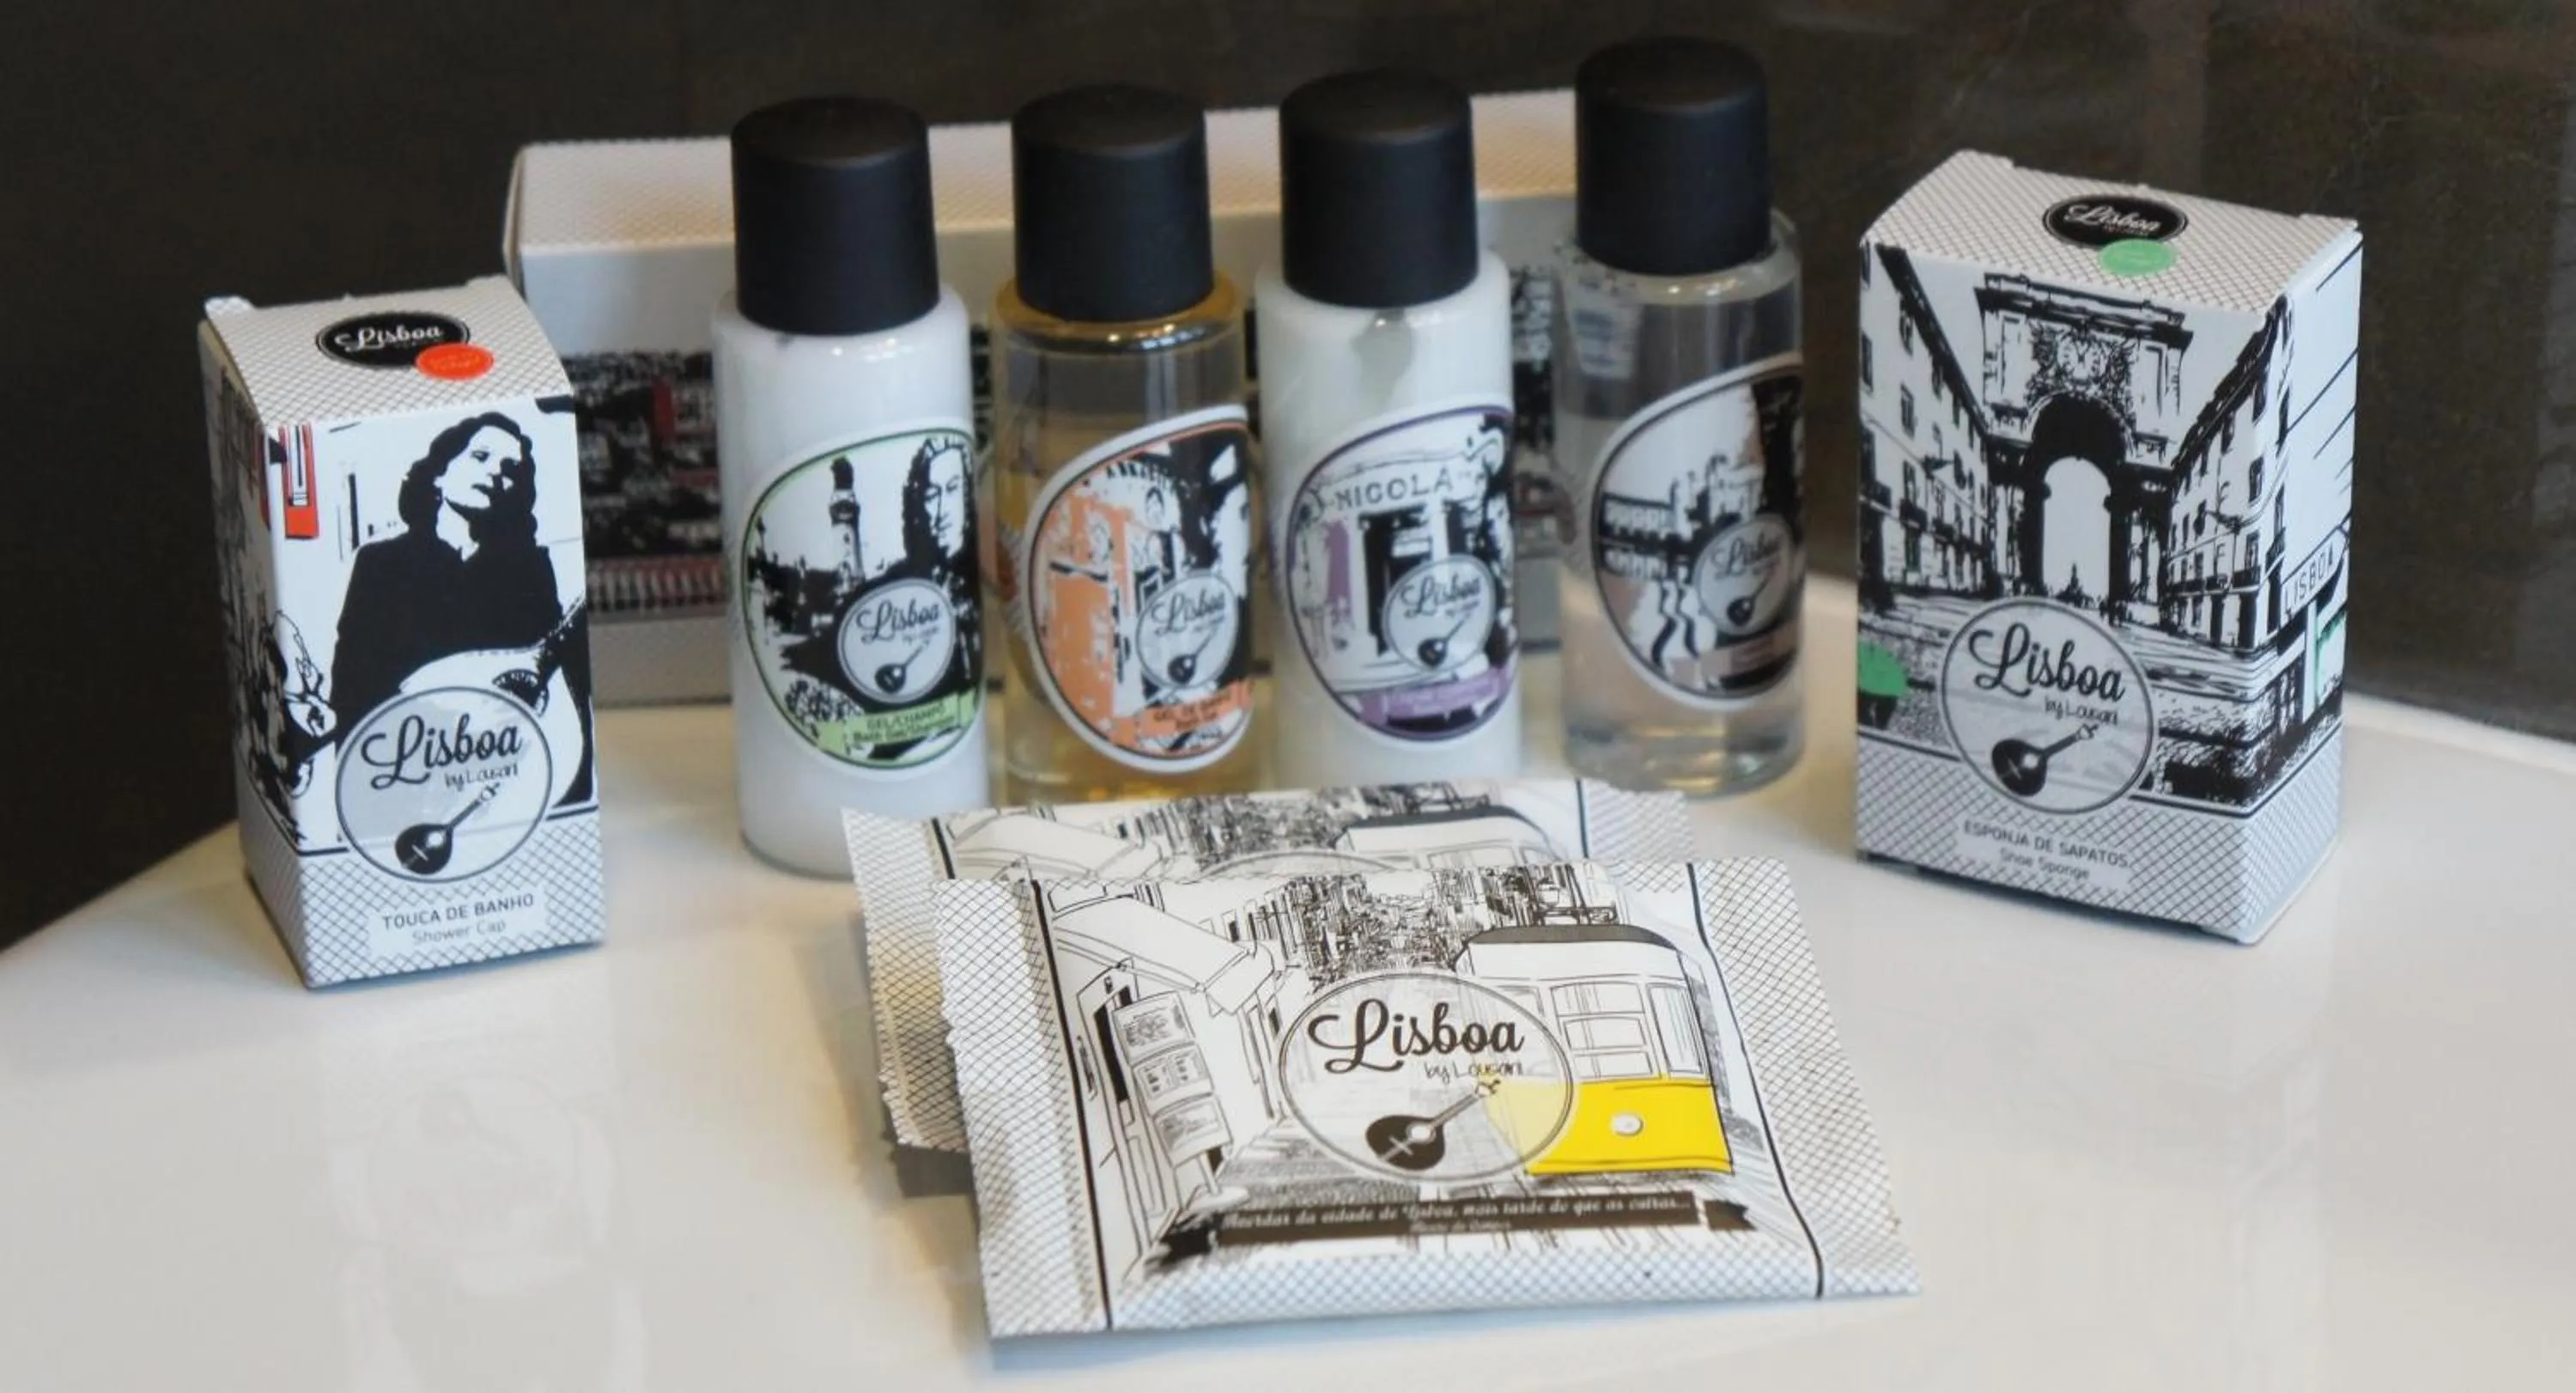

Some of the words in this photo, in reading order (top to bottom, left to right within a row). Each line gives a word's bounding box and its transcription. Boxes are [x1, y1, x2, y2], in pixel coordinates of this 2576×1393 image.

[2064, 204, 2161, 232] Lisboa
[334, 325, 443, 353] Lisboa
[1335, 467, 1454, 511] NICOLA
[1400, 571, 1480, 618] Lisboa
[2285, 542, 2334, 614] LISBOA
[855, 599, 939, 645] Lisboa
[1968, 623, 2125, 703] Lisboa
[361, 713, 523, 790] Lisboa
[1964, 820, 2030, 847] ESPONJA
[2034, 836, 2054, 853] DE
[2058, 841, 2129, 868] SAPATOS
[2000, 847, 2034, 867] Shoe
[2038, 857, 2090, 880] Sponge
[382, 909, 441, 930] TOUCA
[446, 905, 468, 921] DE
[474, 893, 534, 916] BANHO
[412, 925, 471, 943] Shower
[477, 920, 507, 936] Cap
[1308, 998, 1525, 1074] Lisboa
[1425, 1061, 1451, 1085] by
[1379, 1205, 1398, 1220] de
